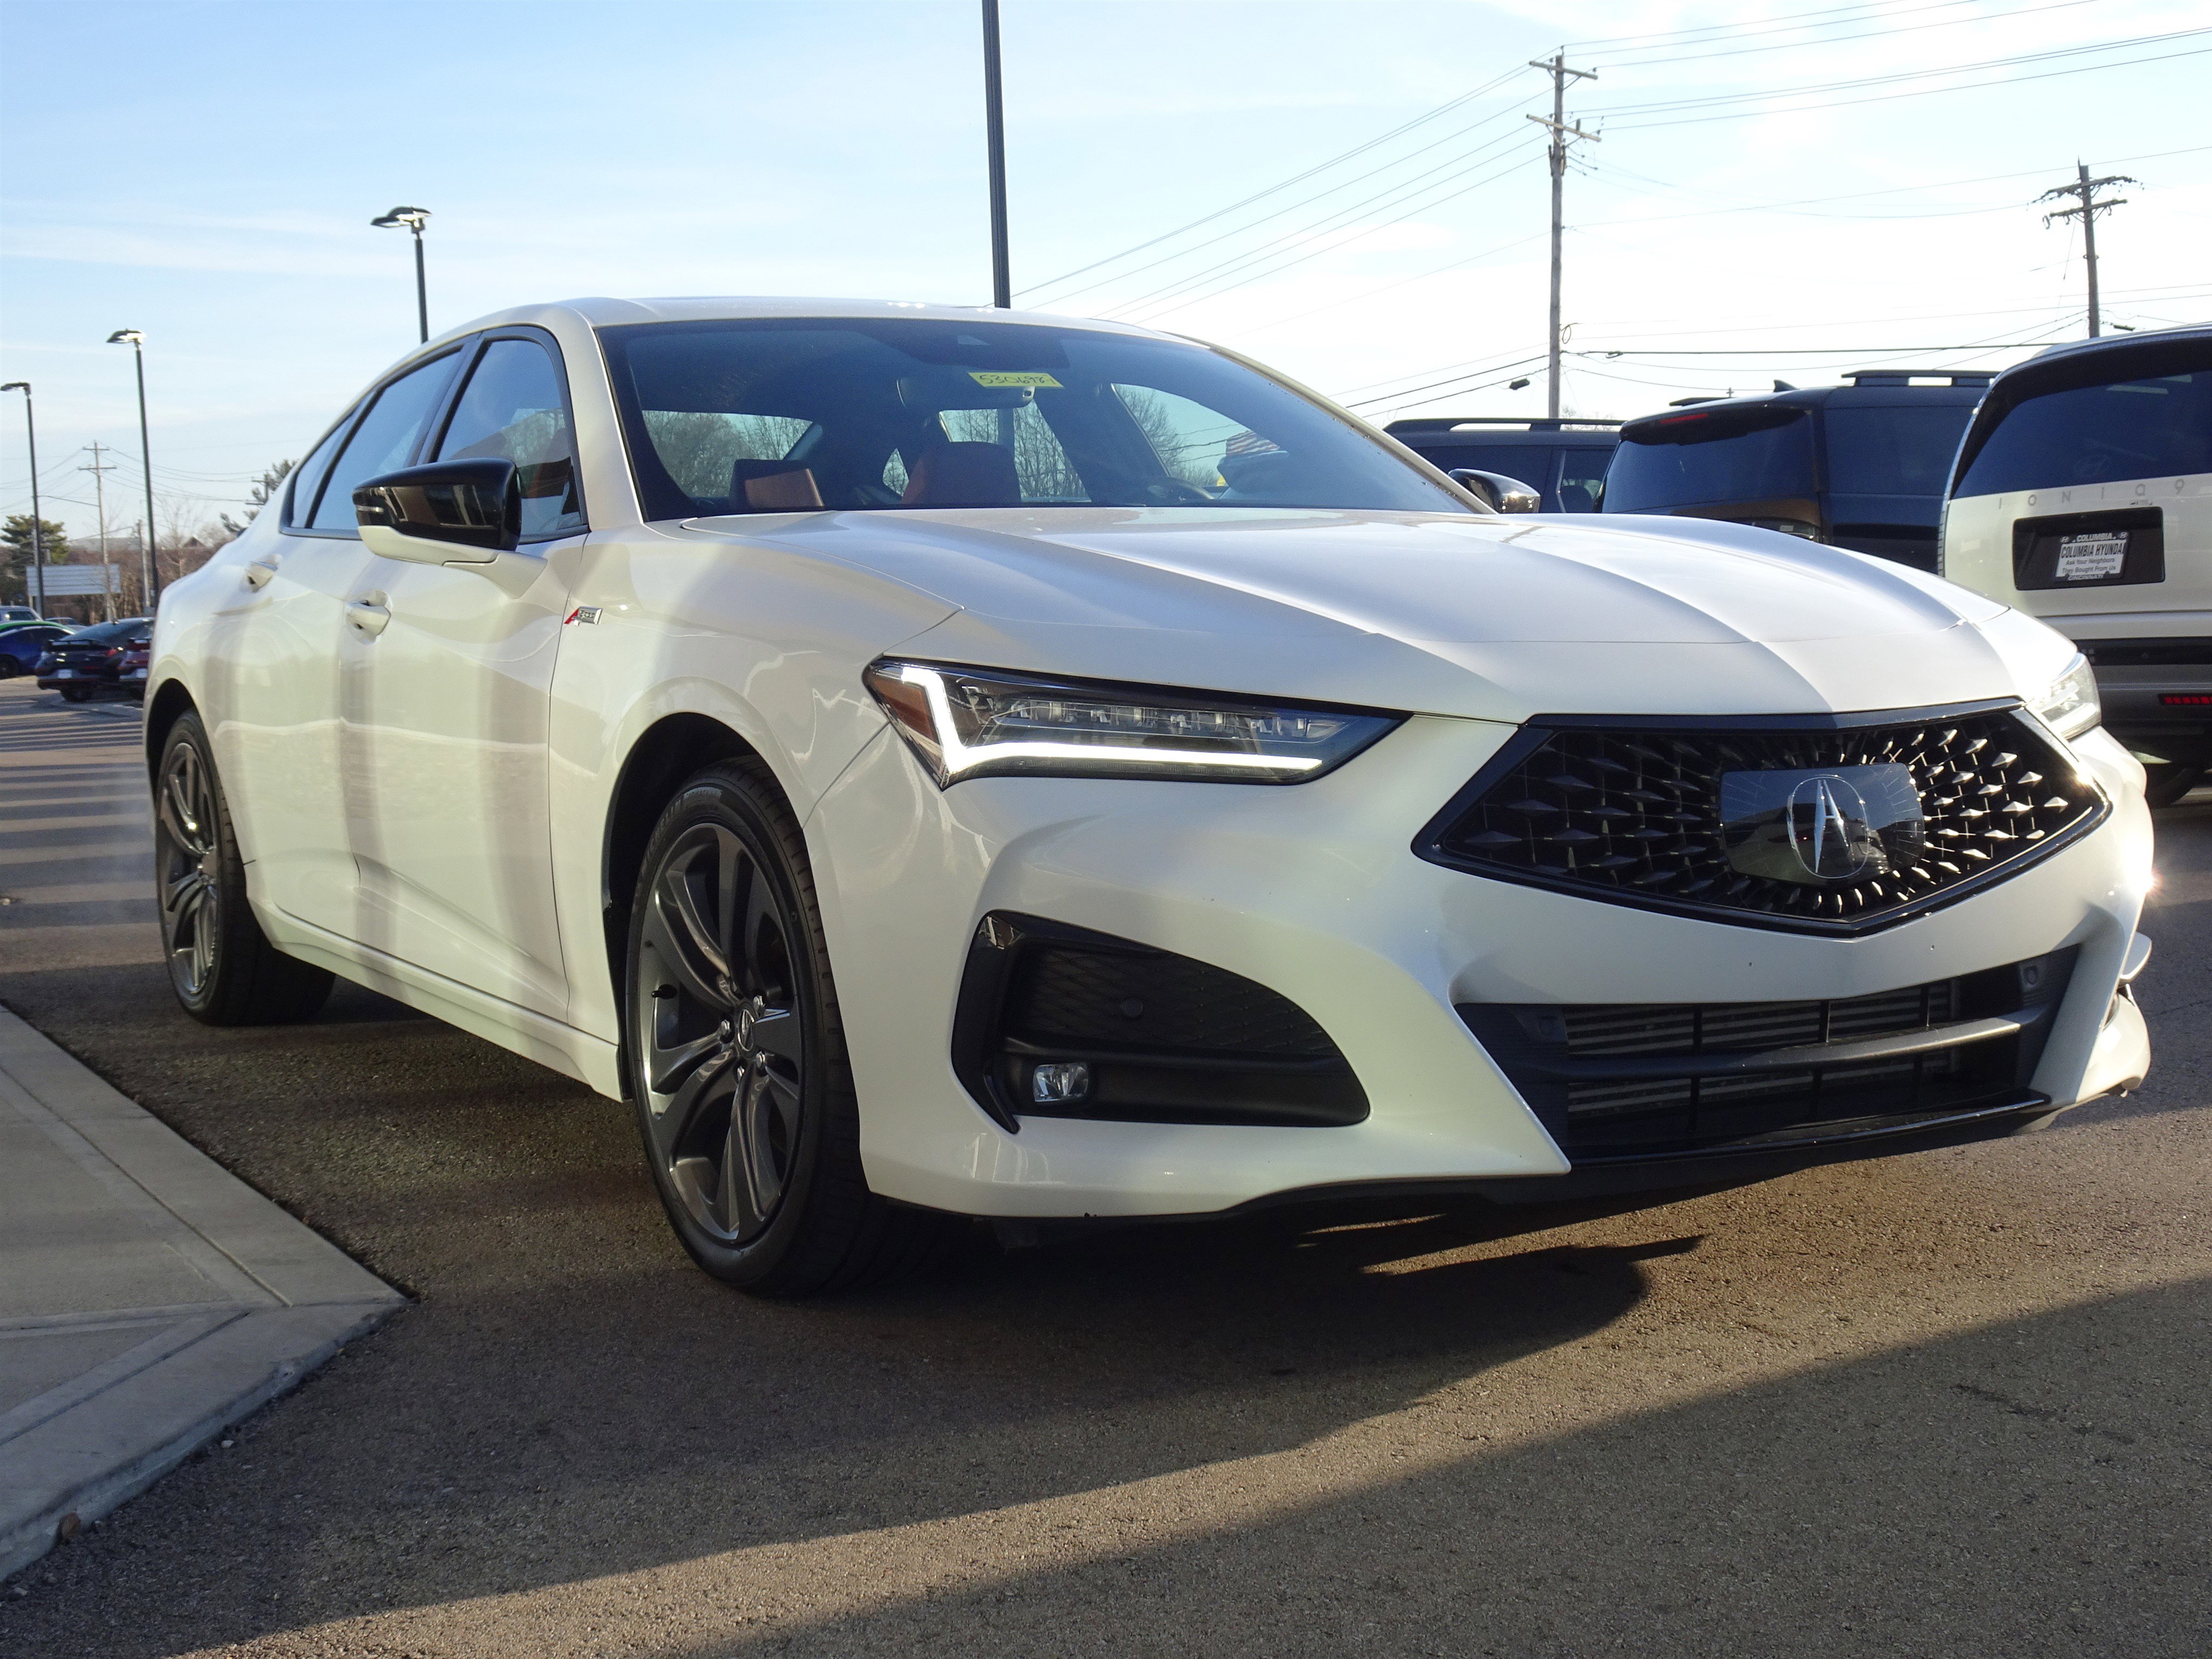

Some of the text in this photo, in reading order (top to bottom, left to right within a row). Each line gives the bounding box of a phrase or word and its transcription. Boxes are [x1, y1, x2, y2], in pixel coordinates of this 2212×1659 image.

[1998, 478, 2185, 510] IONIQ 9
[2076, 533, 2113, 542] COLUMBIA
[2061, 544, 2094, 558] COLUMBIA
